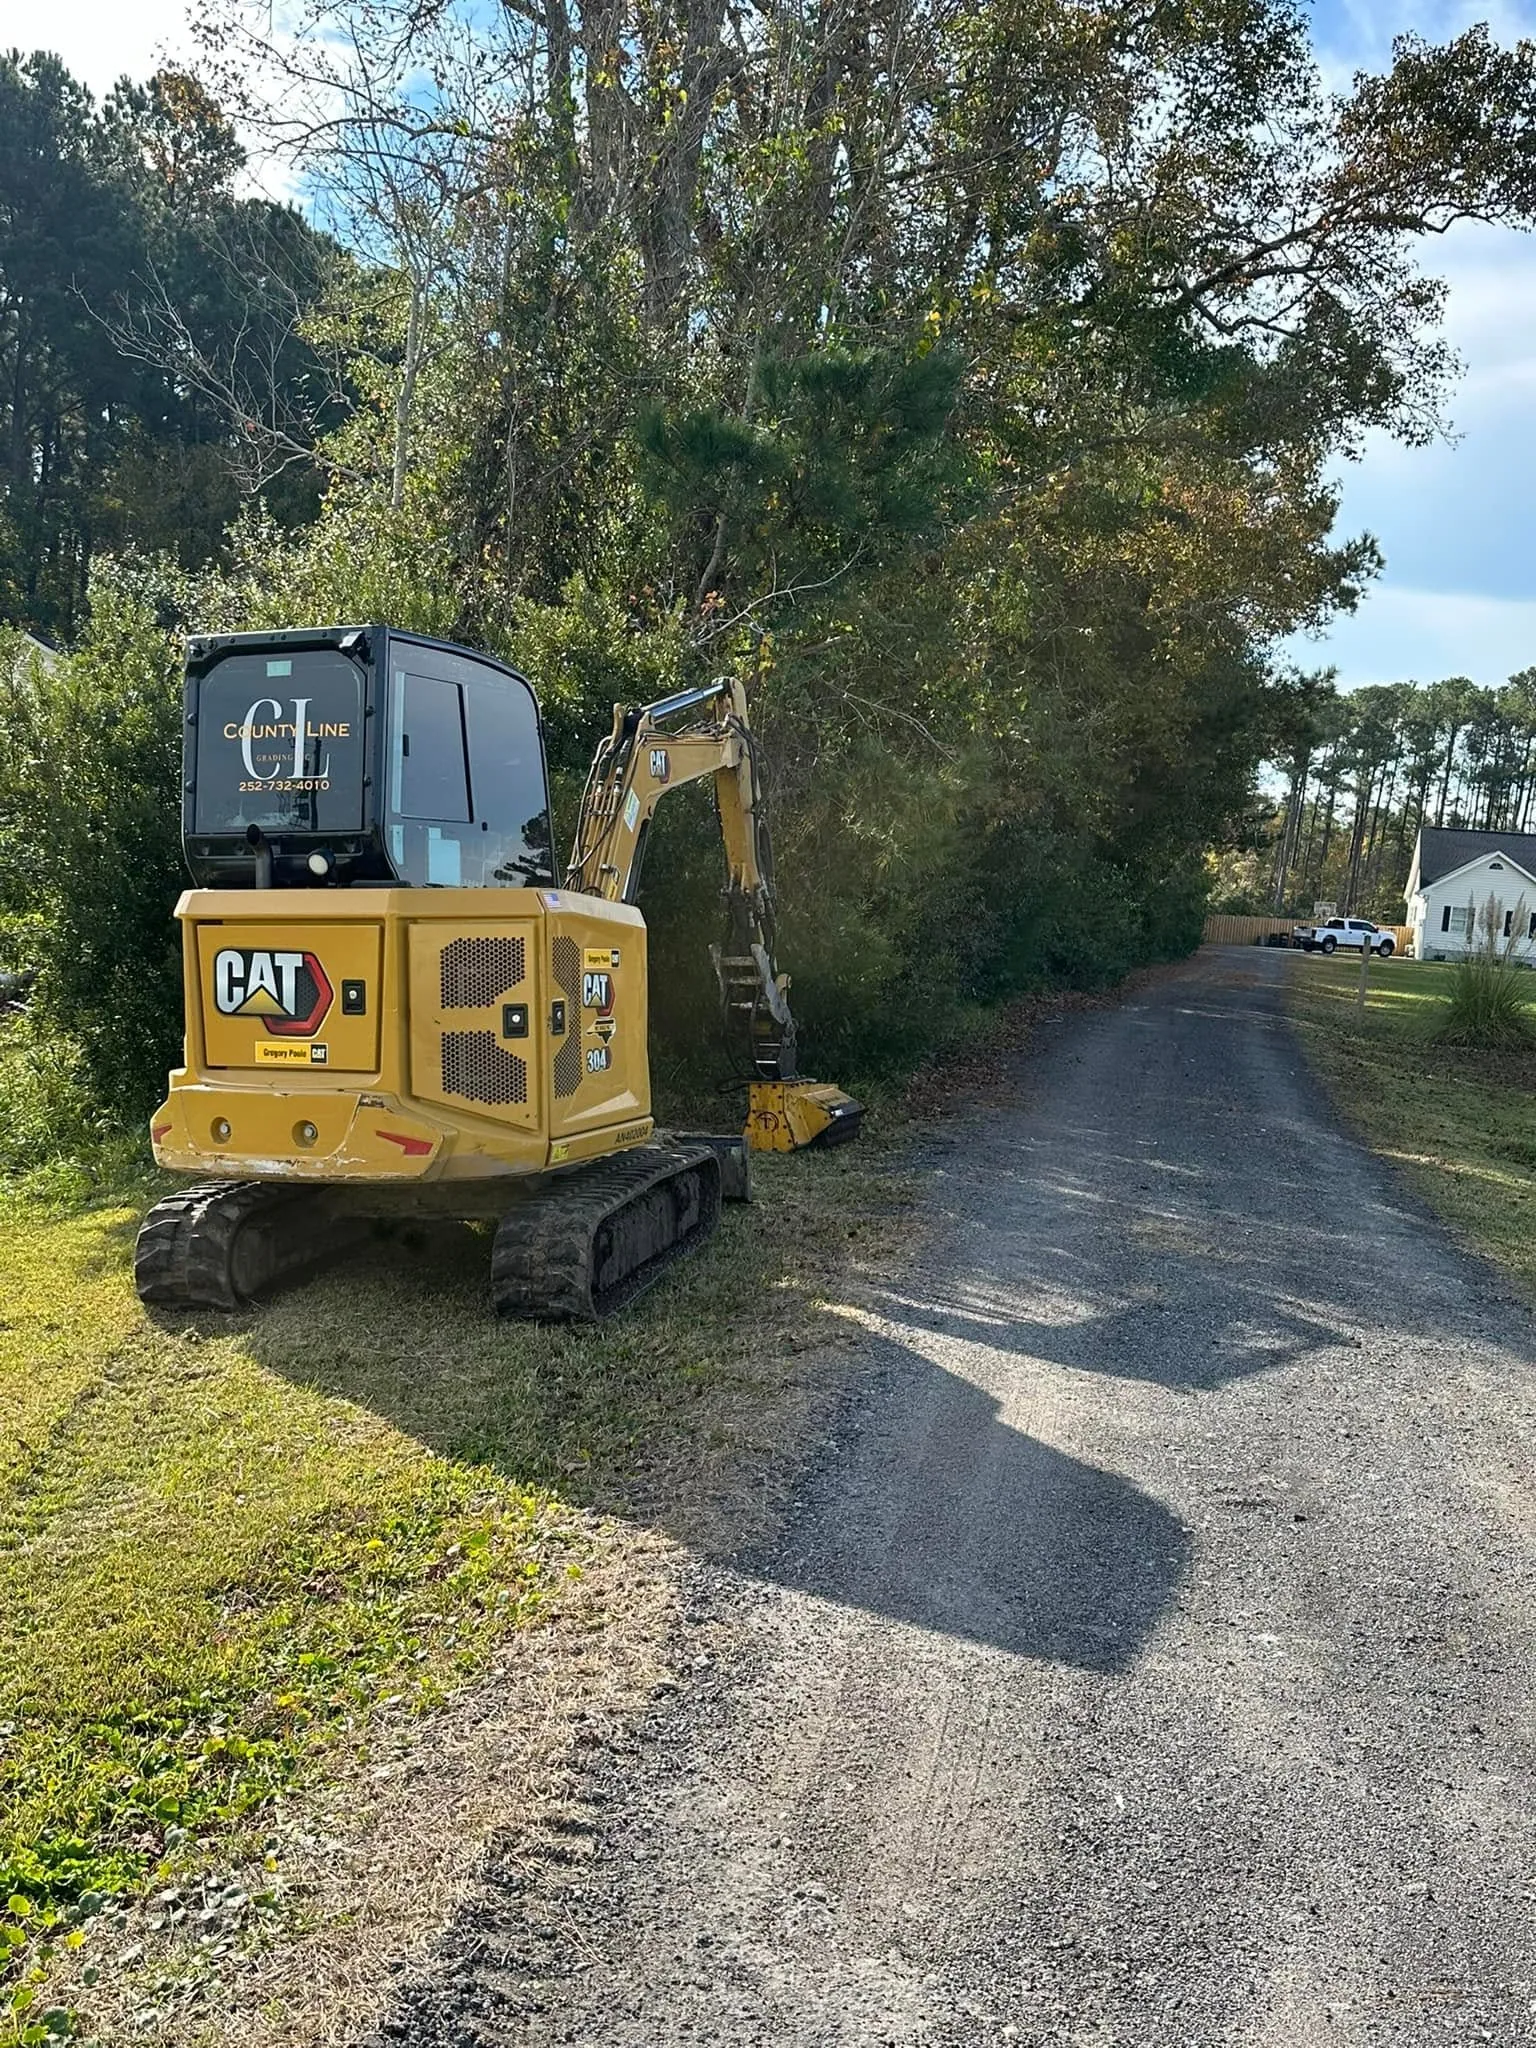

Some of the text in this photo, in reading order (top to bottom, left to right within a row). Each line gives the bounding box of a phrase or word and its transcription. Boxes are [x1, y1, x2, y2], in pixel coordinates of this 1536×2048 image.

[306, 720, 351, 738] LINE
[255, 753, 294, 762] GRADING
[650, 750, 666, 777] CAT
[238, 779, 330, 792] 252-732-4010
[216, 949, 304, 1016] CAT
[584, 973, 609, 1008] CAT
[263, 1047, 288, 1059] Gregory
[312, 1048, 326, 1059] CAT
[587, 1047, 607, 1072] 304
